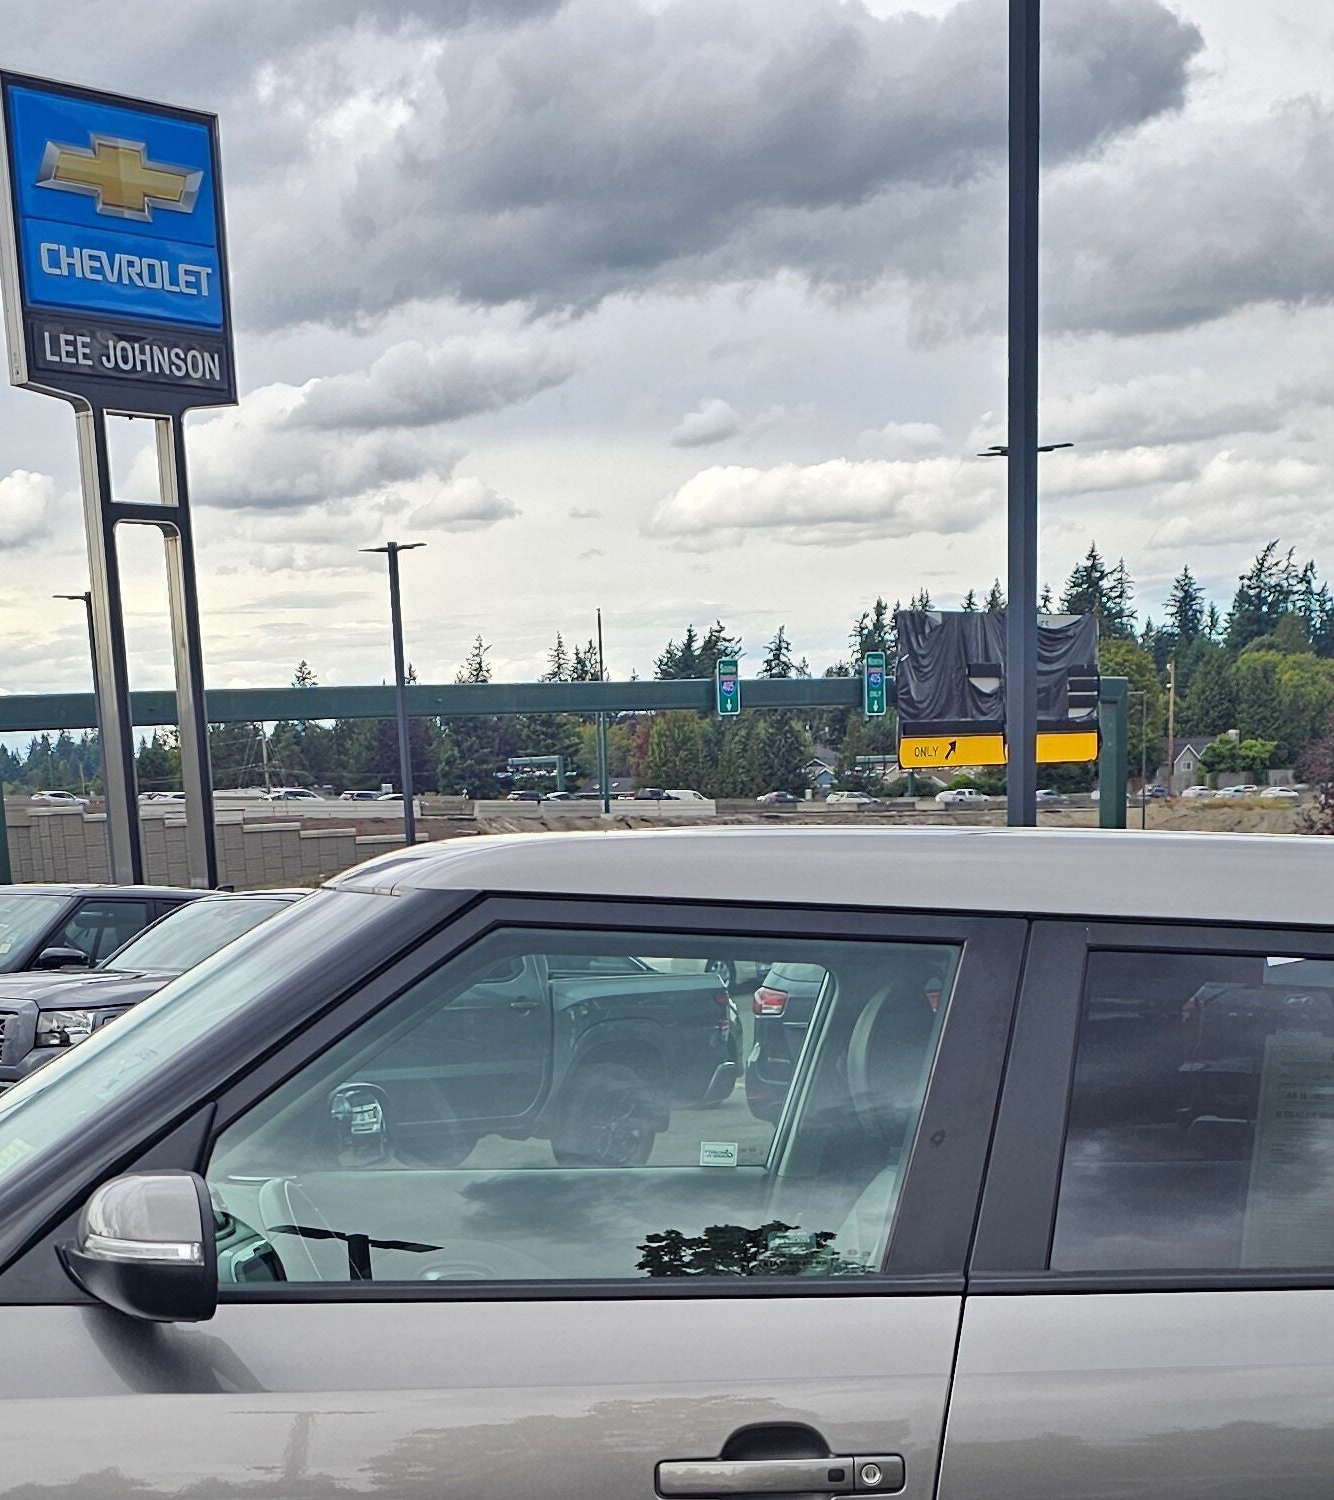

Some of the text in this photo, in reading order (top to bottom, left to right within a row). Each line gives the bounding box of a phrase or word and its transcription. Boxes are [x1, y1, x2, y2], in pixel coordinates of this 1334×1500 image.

[40, 242, 212, 296] CHEVROLET
[44, 331, 220, 380] LEE JOHNSON
[914, 746, 939, 757] ONLY
